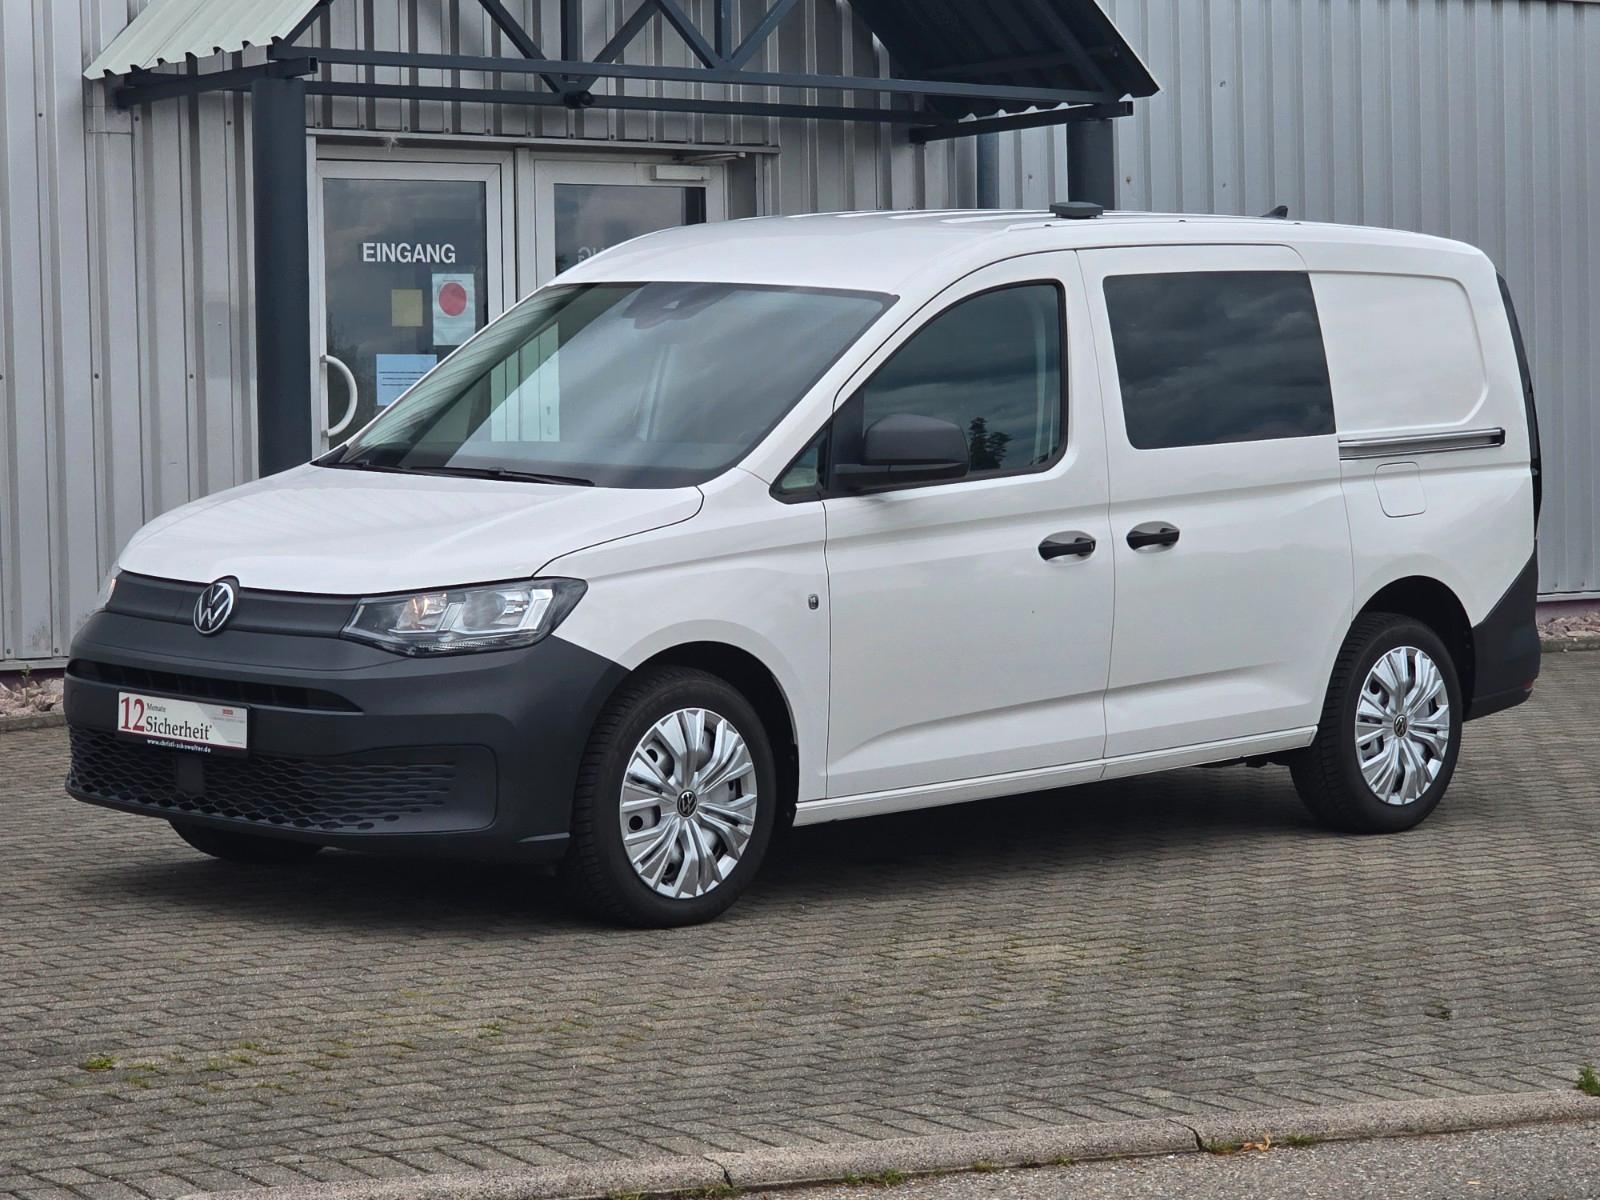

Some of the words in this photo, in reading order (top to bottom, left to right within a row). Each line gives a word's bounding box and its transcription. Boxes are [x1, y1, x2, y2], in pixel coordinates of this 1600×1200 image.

[362, 242, 457, 264] EINGANG
[194, 582, 234, 634] VW
[120, 696, 145, 732] 12
